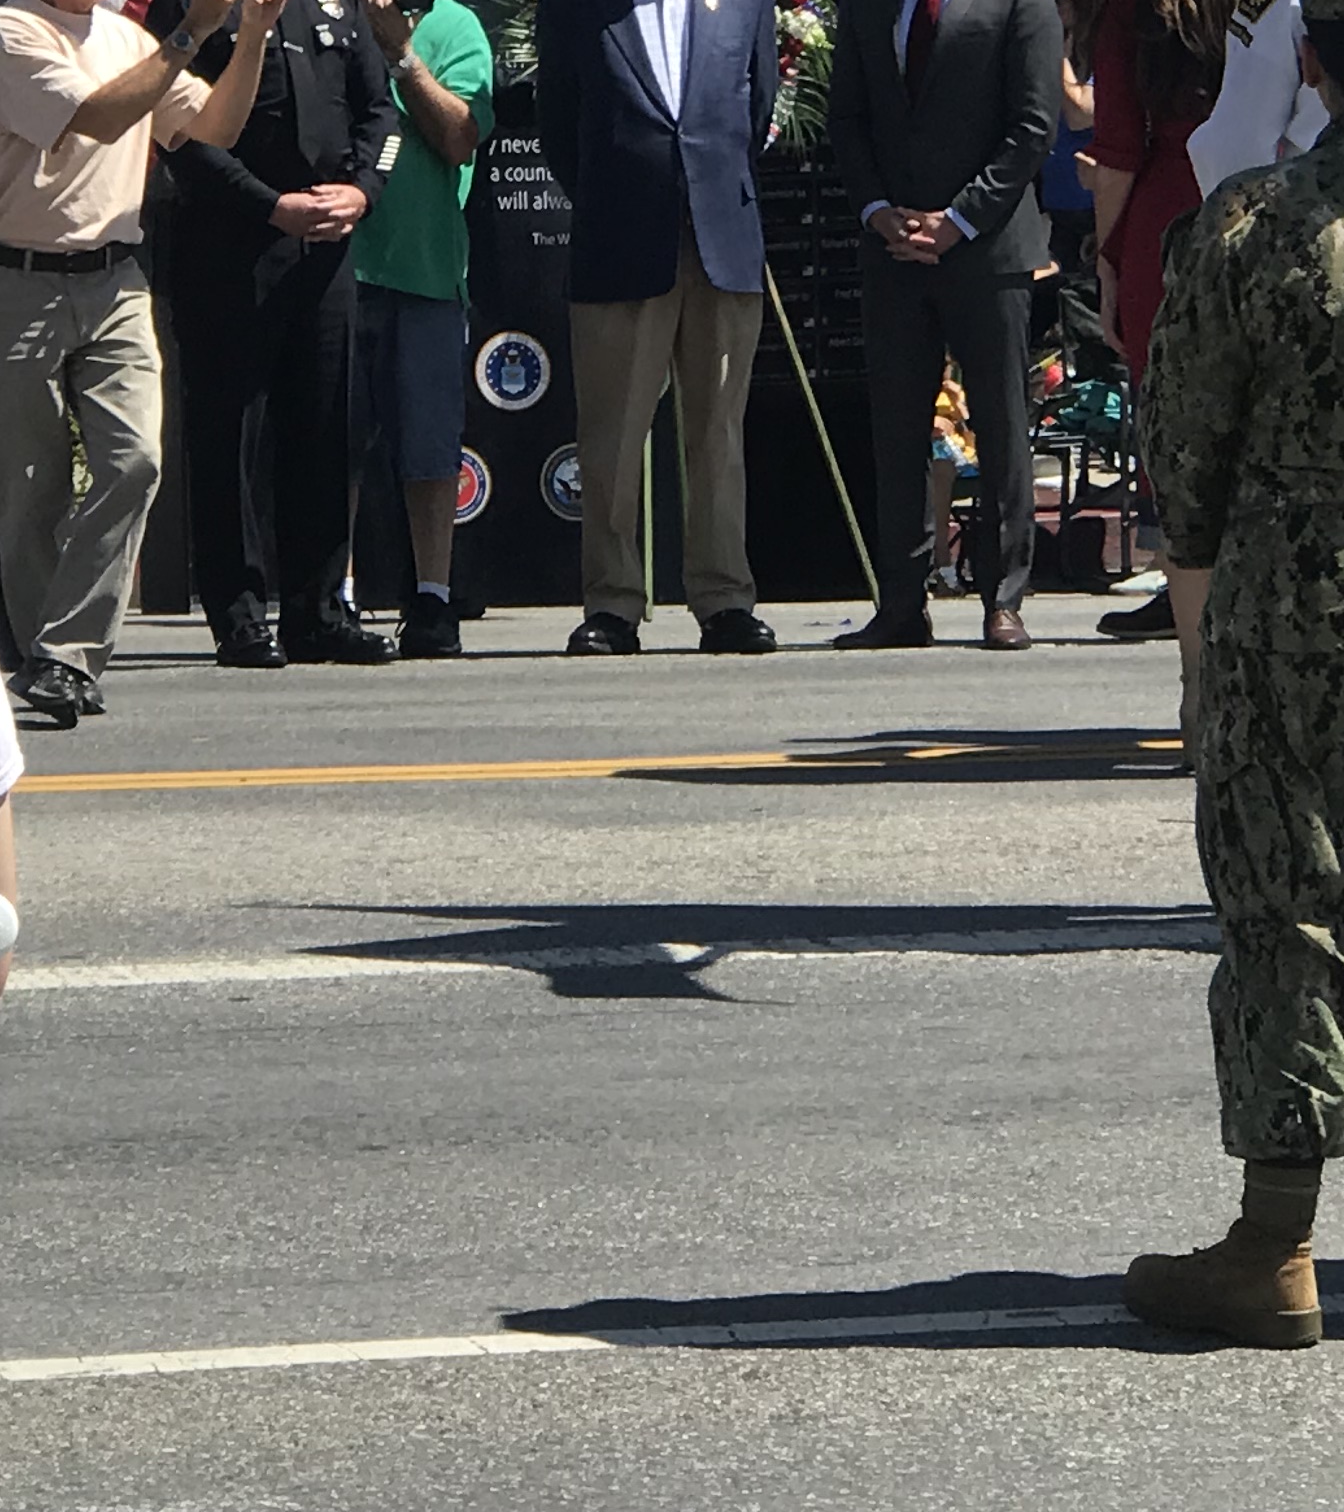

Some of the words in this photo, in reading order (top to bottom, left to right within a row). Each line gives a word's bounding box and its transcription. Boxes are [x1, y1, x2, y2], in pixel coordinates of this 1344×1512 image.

[501, 138, 541, 154] neve
[490, 167, 500, 182] a
[504, 166, 554, 182] count
[497, 190, 528, 210] will
[532, 232, 555, 245] The
